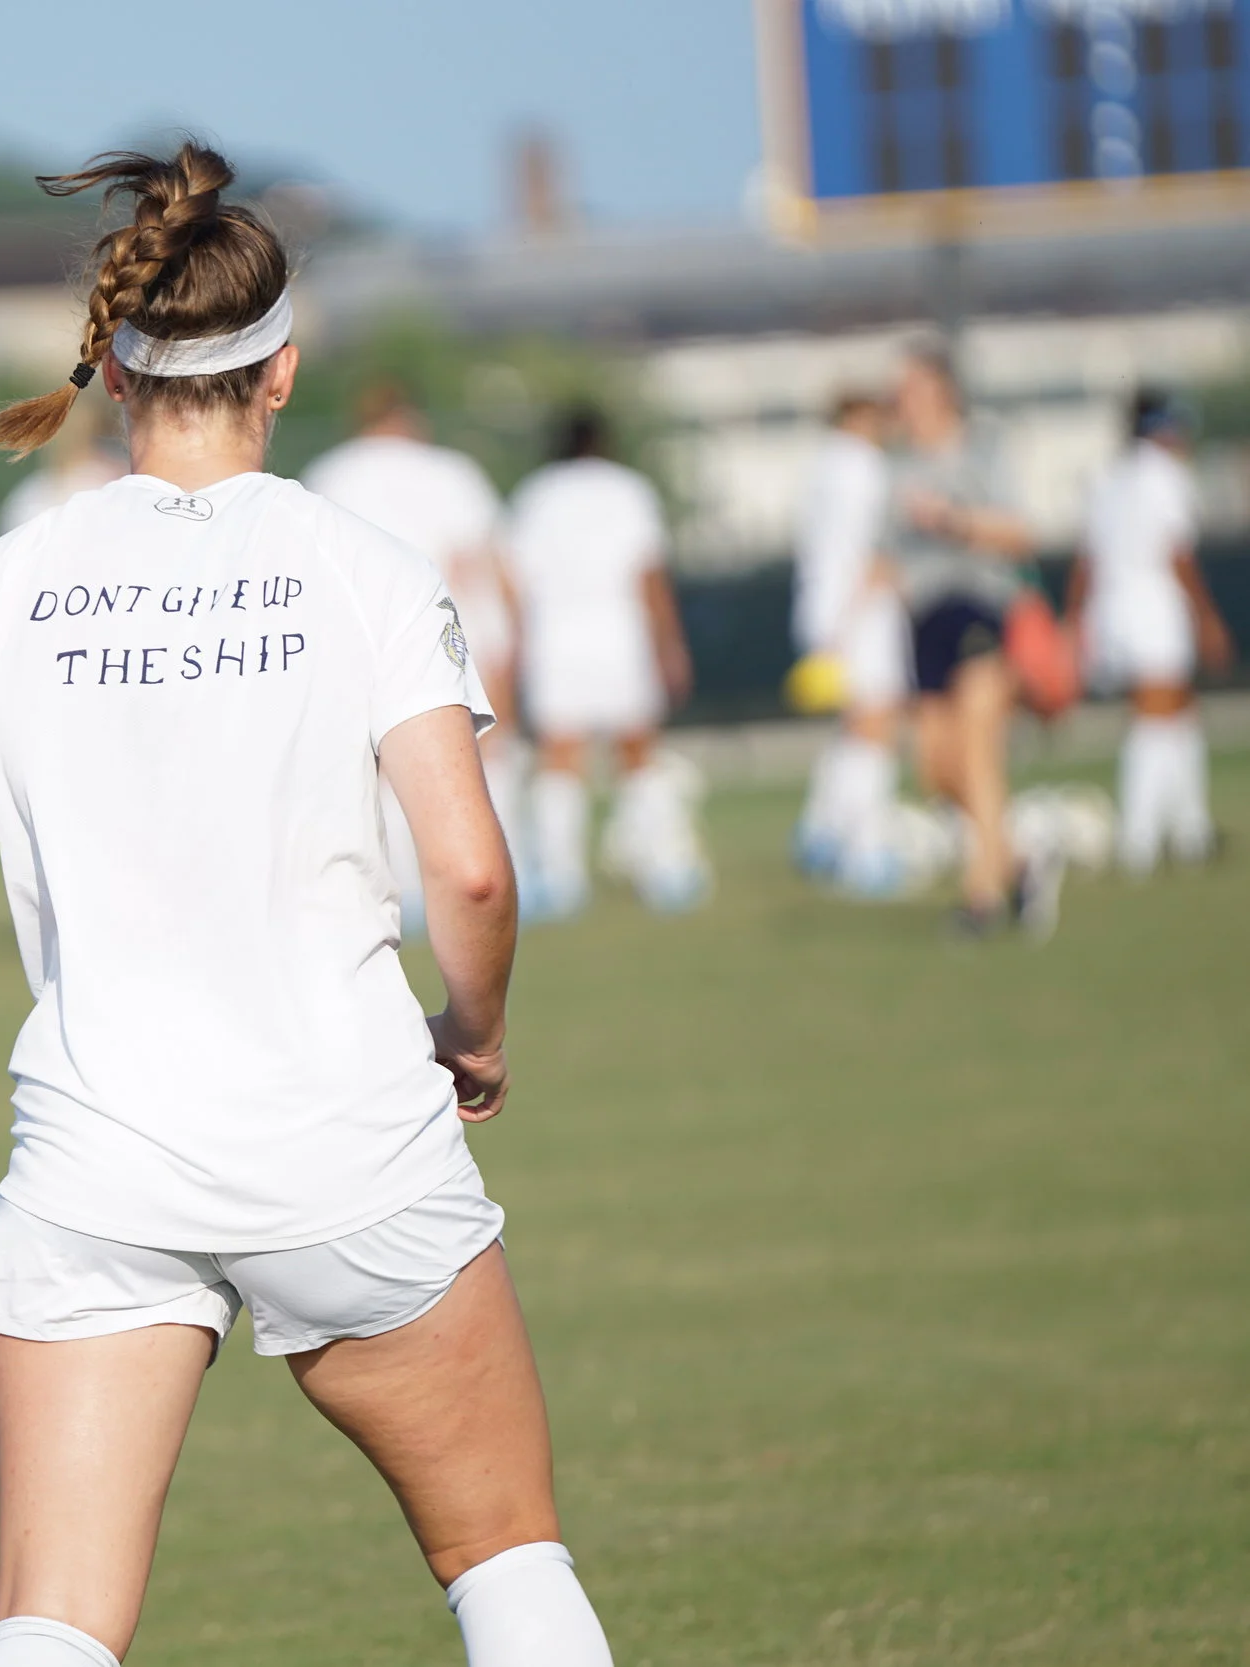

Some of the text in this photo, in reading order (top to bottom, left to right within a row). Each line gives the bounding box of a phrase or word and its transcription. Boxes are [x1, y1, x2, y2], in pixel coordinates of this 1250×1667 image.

[29, 575, 303, 622] DONT GIVE UP
[56, 632, 305, 685] THE SHIP
